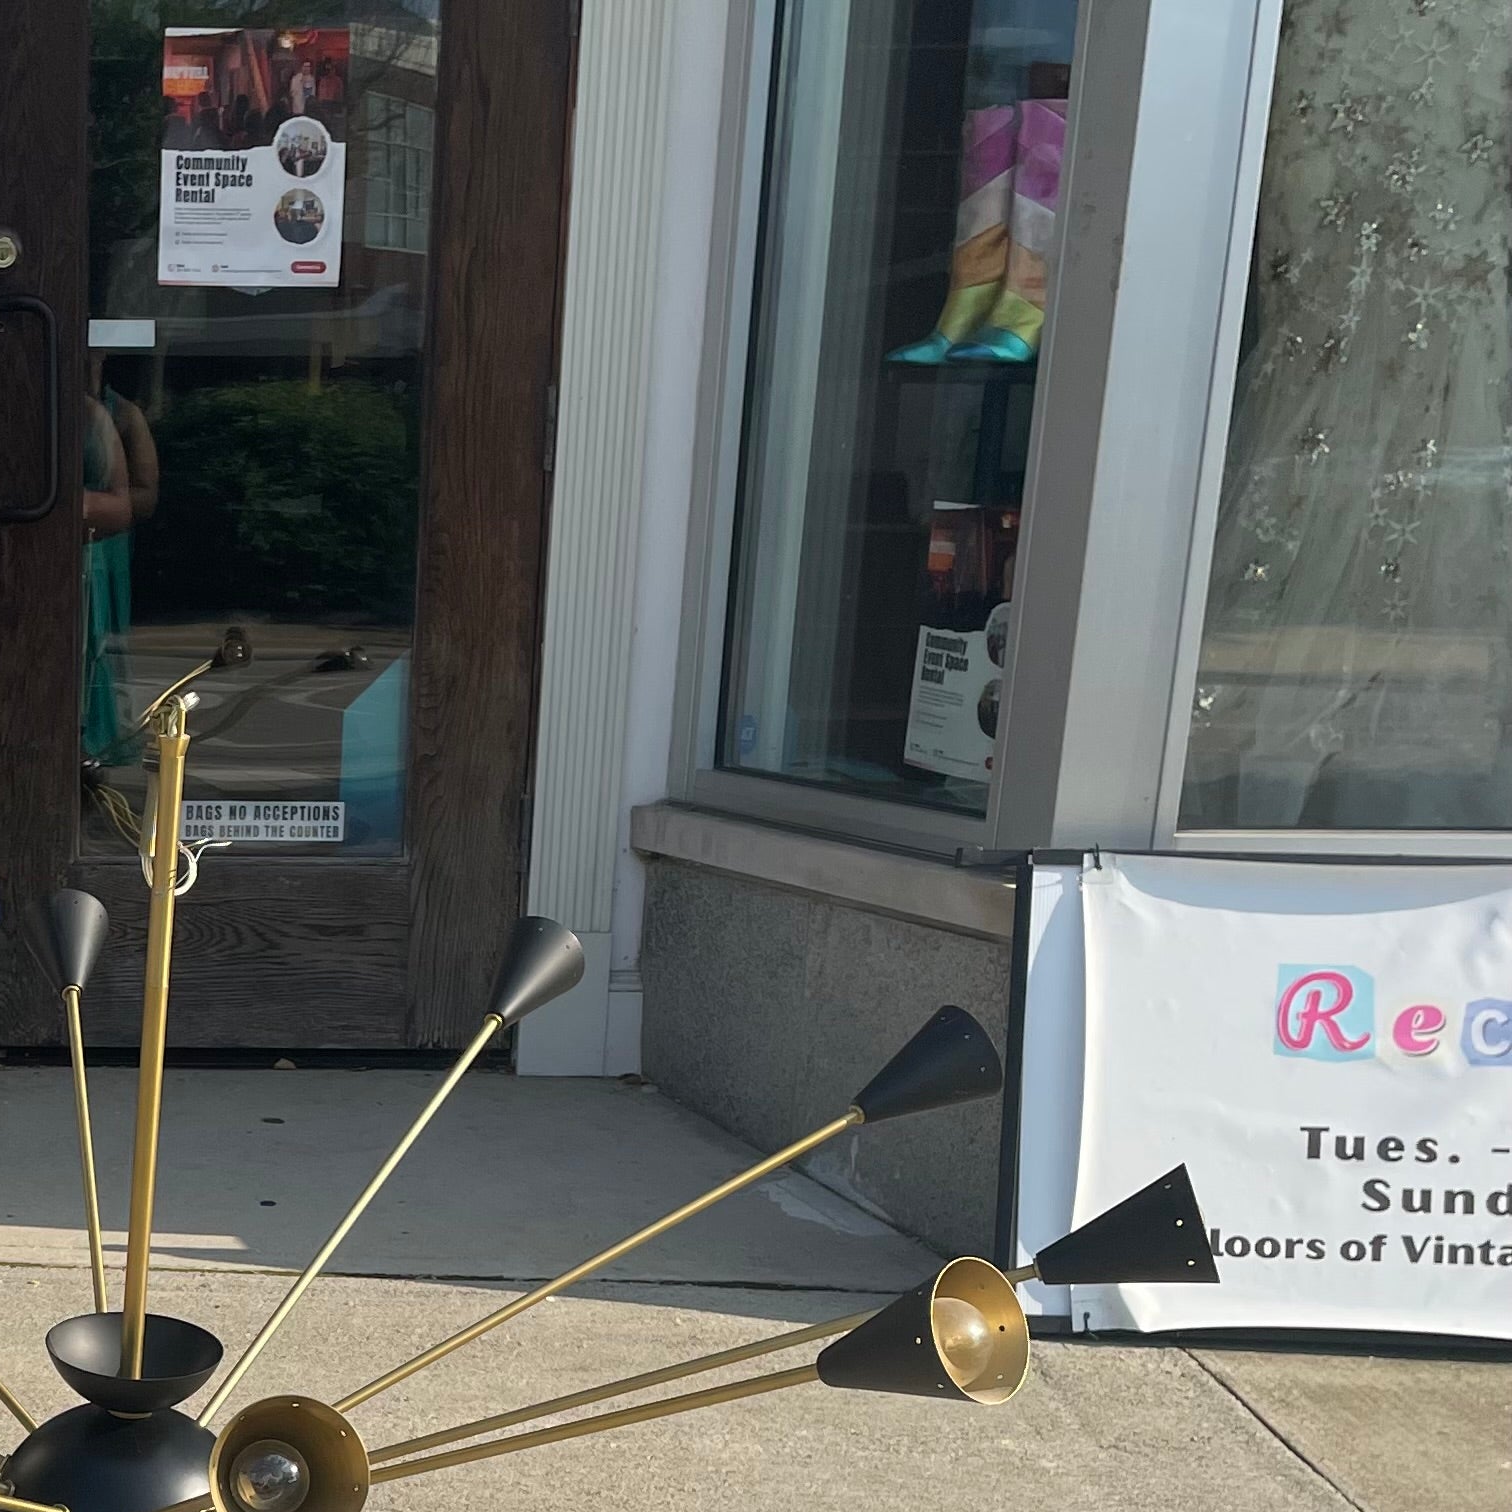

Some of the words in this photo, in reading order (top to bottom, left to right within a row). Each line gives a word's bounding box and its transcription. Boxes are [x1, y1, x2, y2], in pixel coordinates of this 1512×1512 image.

[175, 154, 248, 173] Community
[175, 171, 210, 187] Event
[214, 171, 253, 188] Space
[175, 187, 215, 203] Rental
[185, 804, 223, 821] BAGS
[228, 804, 247, 821] NO
[184, 824, 215, 838] BAGS
[219, 825, 260, 838] BEHIND
[264, 825, 285, 838] THE
[289, 825, 339, 838] COUNTER
[1300, 1126, 1461, 1164] Tues.
[1340, 1235, 1388, 1262] of
